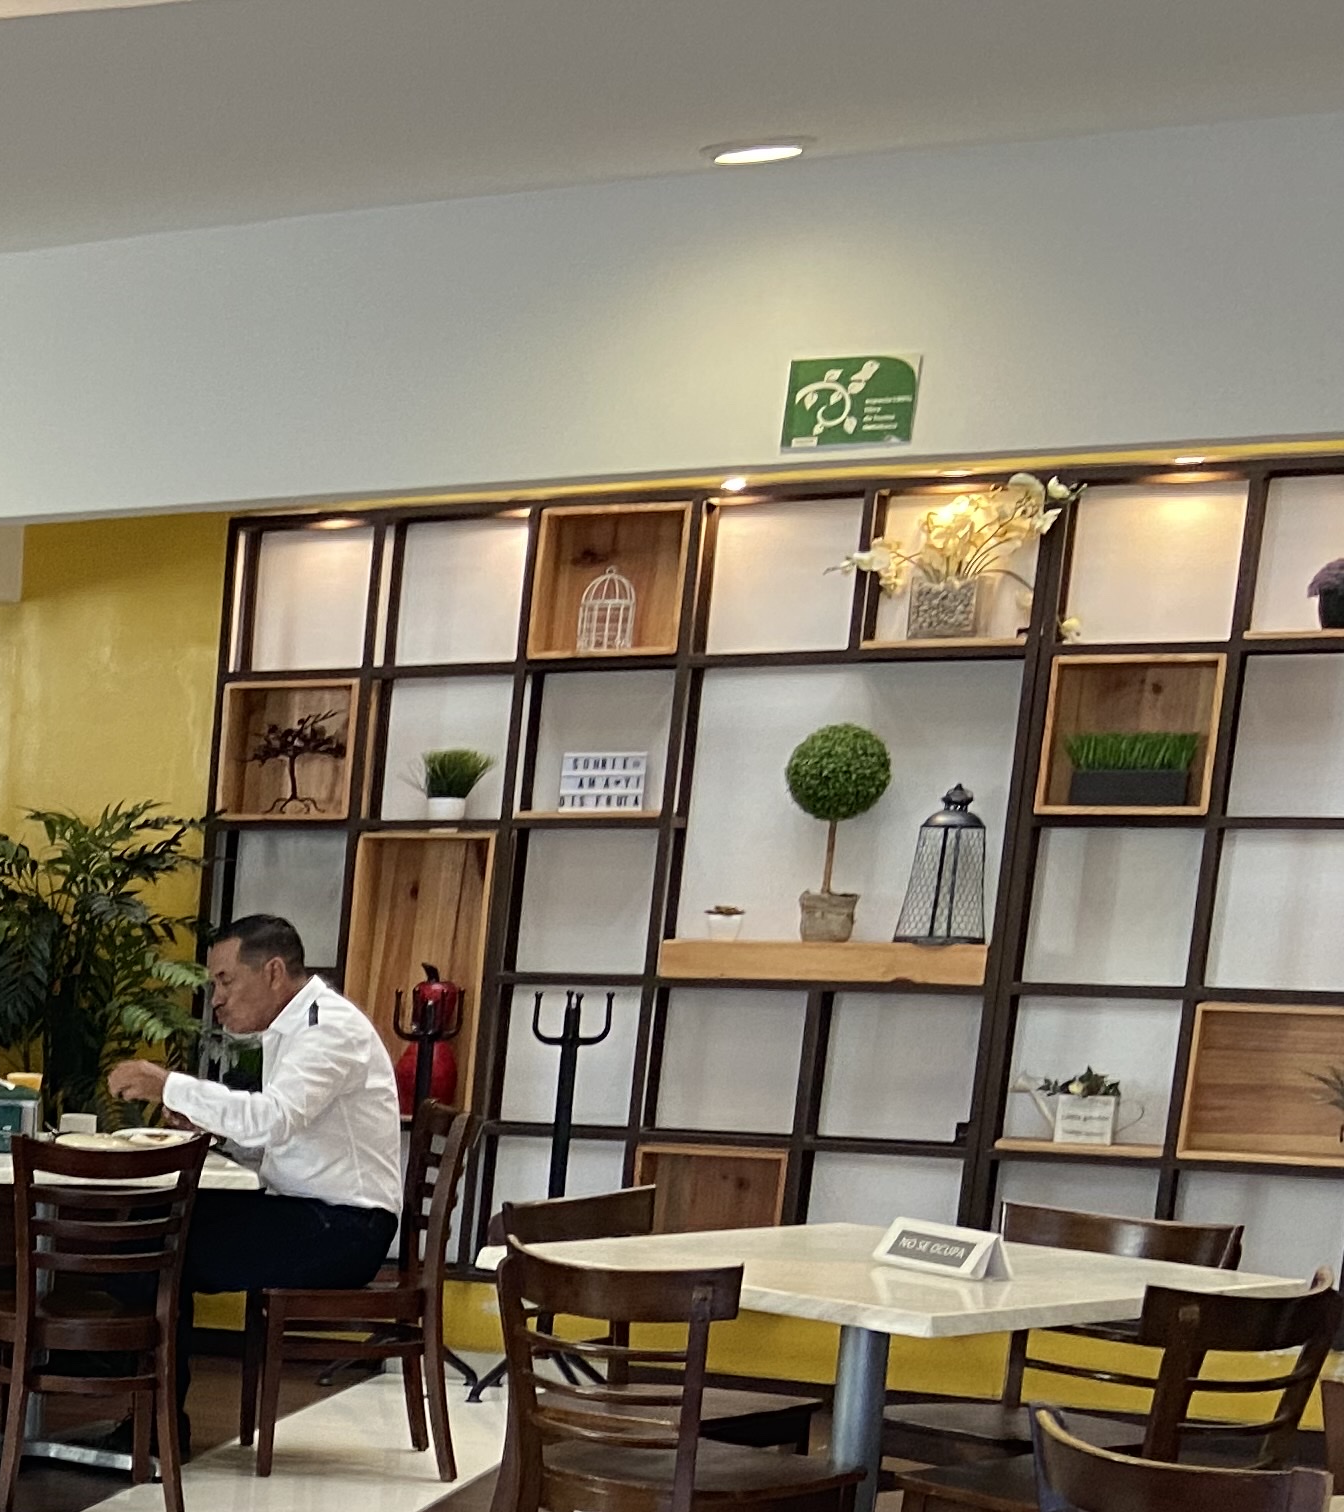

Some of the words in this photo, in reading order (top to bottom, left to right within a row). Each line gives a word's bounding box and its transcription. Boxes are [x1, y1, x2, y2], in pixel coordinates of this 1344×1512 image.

[898, 1237, 917, 1248] NO
[917, 1240, 931, 1252] SE
[930, 1243, 966, 1259] OCUPA
